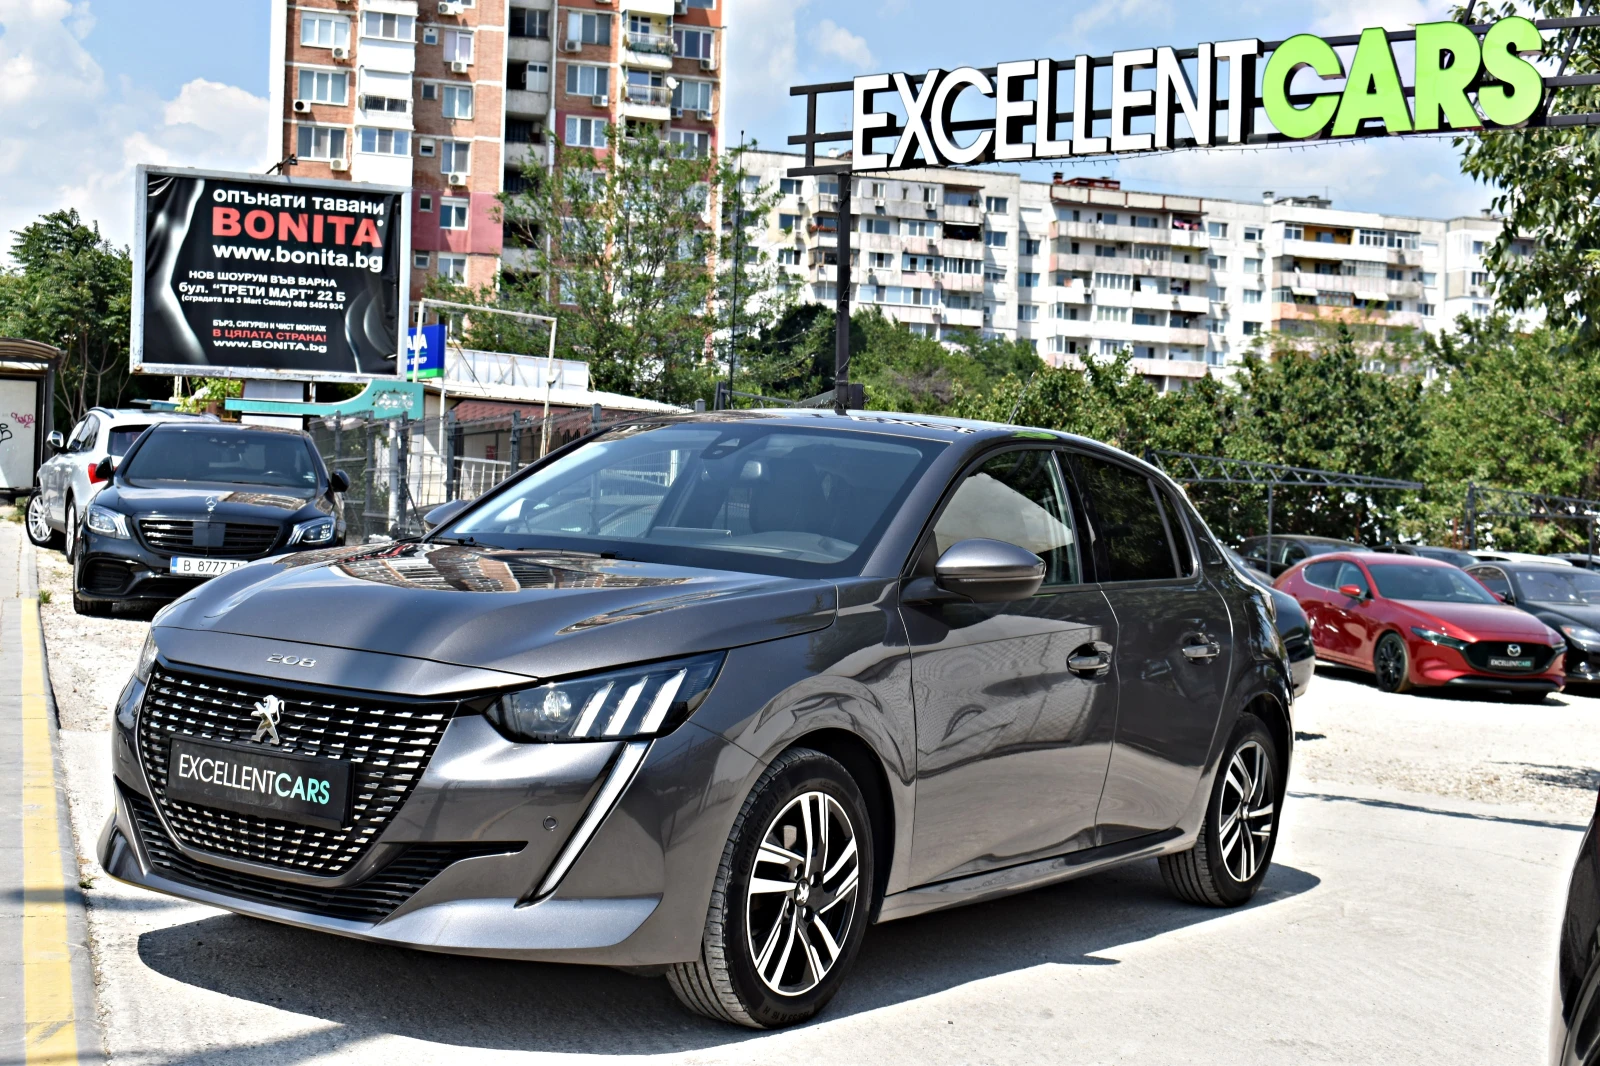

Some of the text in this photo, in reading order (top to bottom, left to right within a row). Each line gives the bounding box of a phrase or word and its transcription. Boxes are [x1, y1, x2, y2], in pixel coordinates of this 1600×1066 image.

[852, 16, 1544, 171] EXCELLENTCARS
[213, 189, 384, 216] опънати тавани
[212, 206, 383, 248] BONITA
[212, 244, 383, 273] www.bonita.bg
[189, 270, 337, 288] НОВ ШОУРУМ ВЪВ ВАРНА
[178, 282, 209, 295] бул.
[317, 291, 333, 301] 22
[336, 292, 346, 302] Б
[236, 296, 242, 304] 3
[243, 297, 262, 305] Mart
[263, 298, 292, 308] Center)
[212, 319, 236, 328] БЪРЗ,
[236, 320, 269, 329] СИГУРЕН
[212, 328, 327, 342] В ЦЯЛАТА СТРАНА!
[213, 340, 327, 353] www.BONITA.bg
[198, 560, 227, 573] 8777
[266, 653, 317, 668] 208
[178, 753, 331, 805] EXCELLENTCARS
